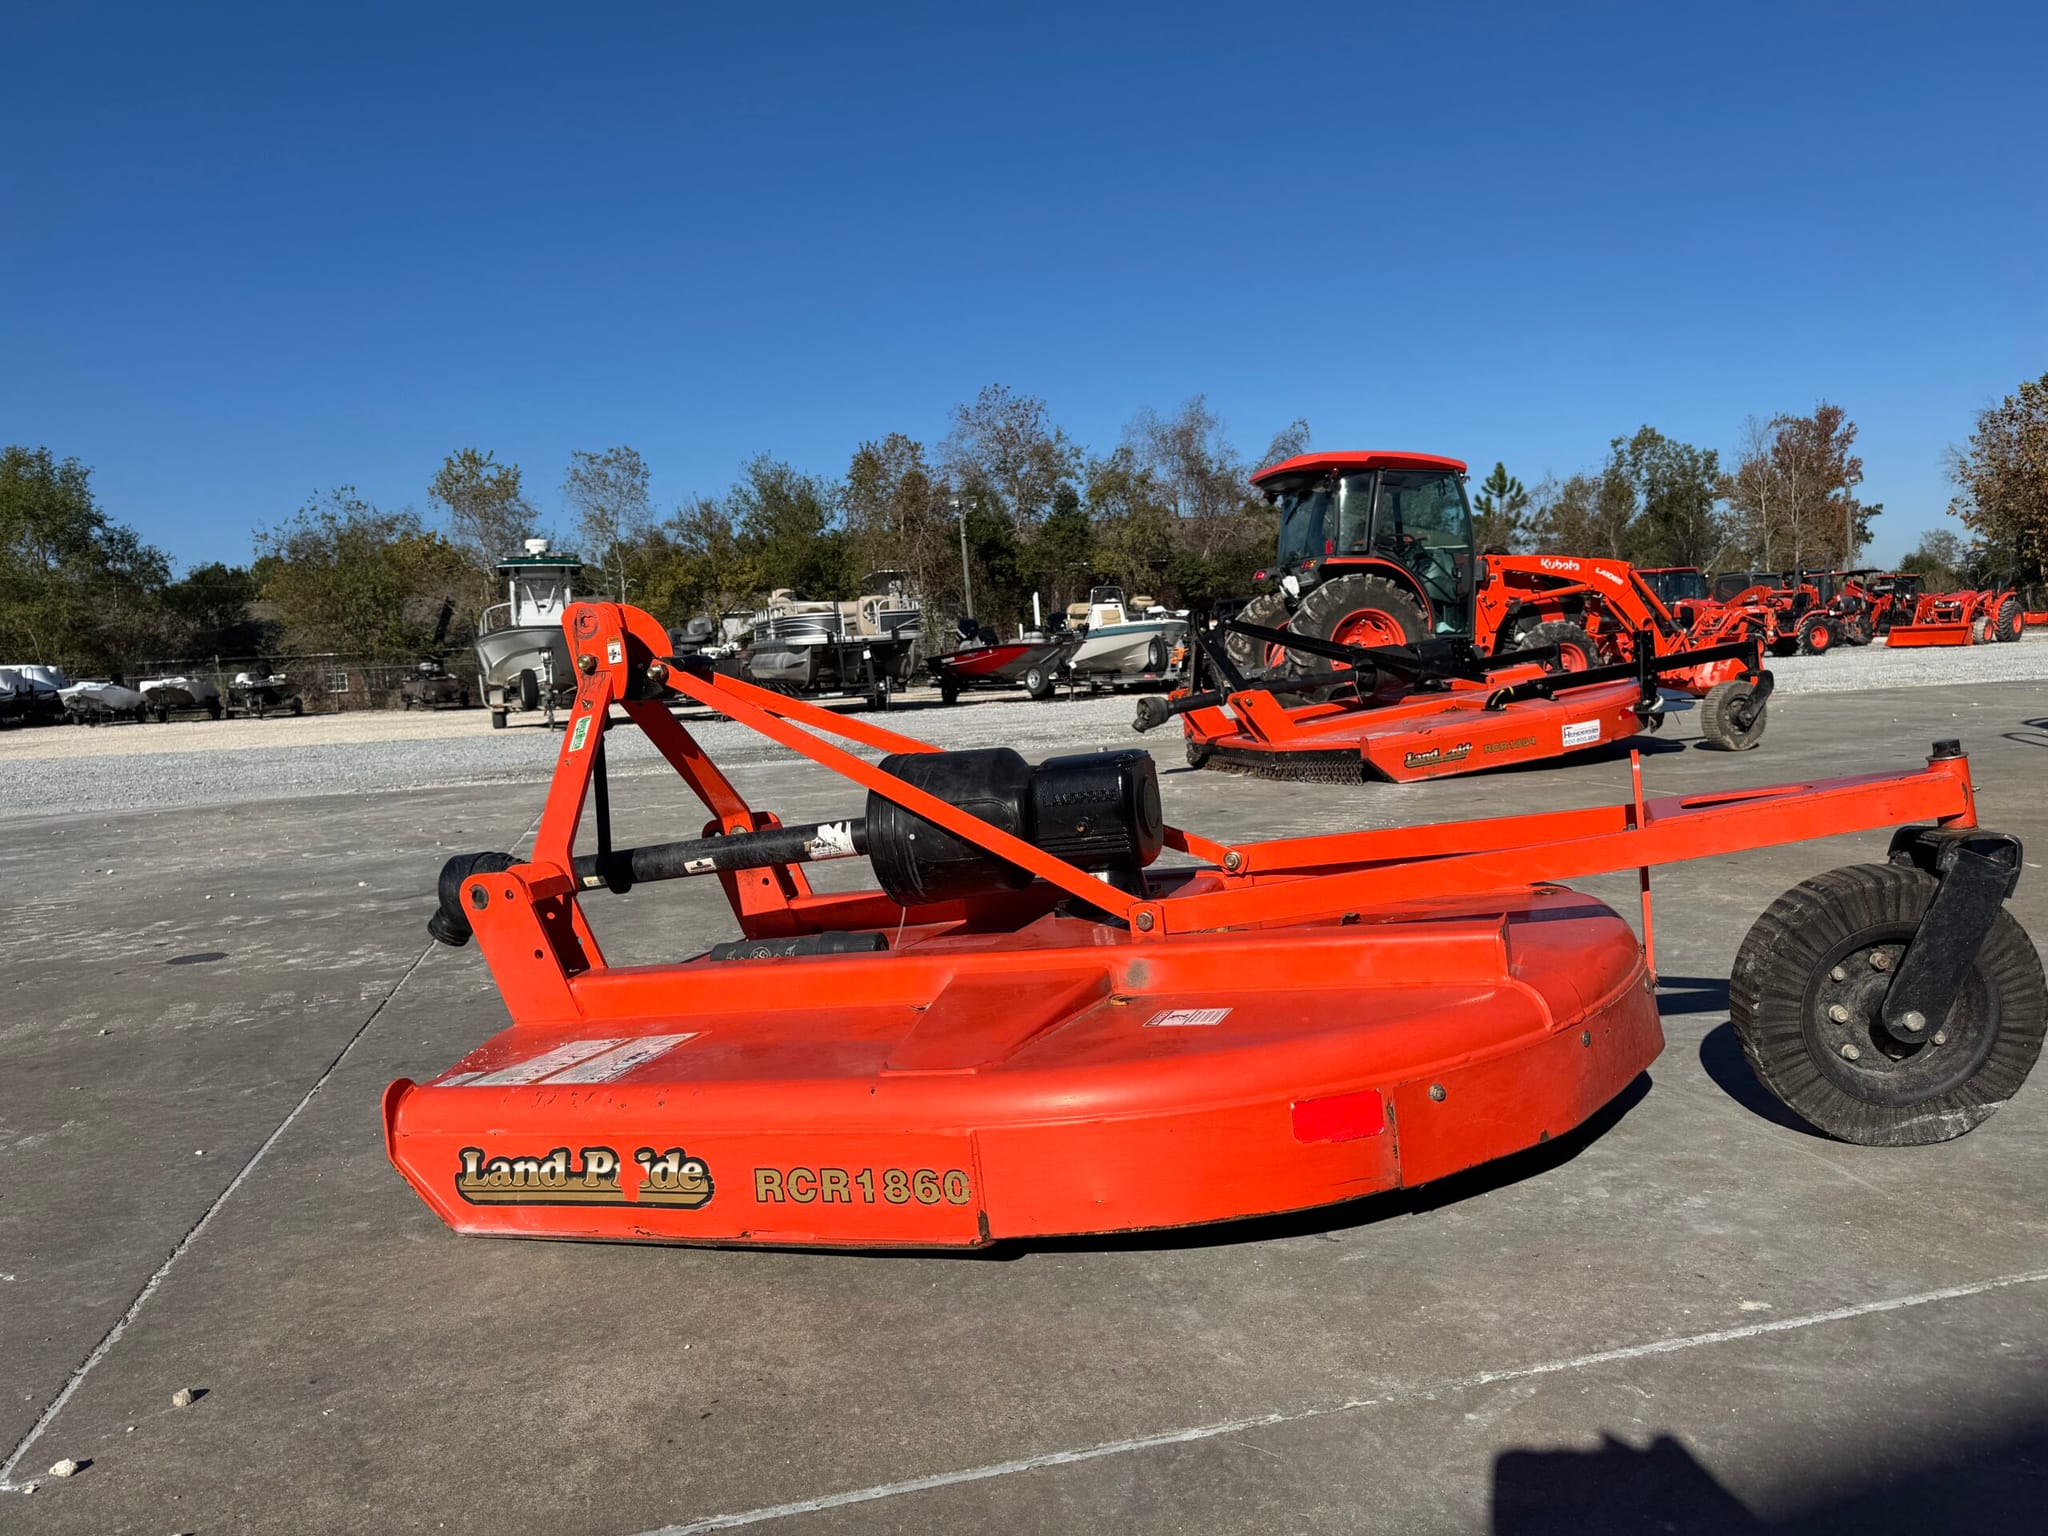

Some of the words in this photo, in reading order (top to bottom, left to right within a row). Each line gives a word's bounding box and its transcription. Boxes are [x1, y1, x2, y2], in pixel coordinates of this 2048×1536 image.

[1540, 558, 1580, 571] Kubota
[461, 1149, 568, 1189] Land
[753, 1167, 973, 1205] RCR1860
